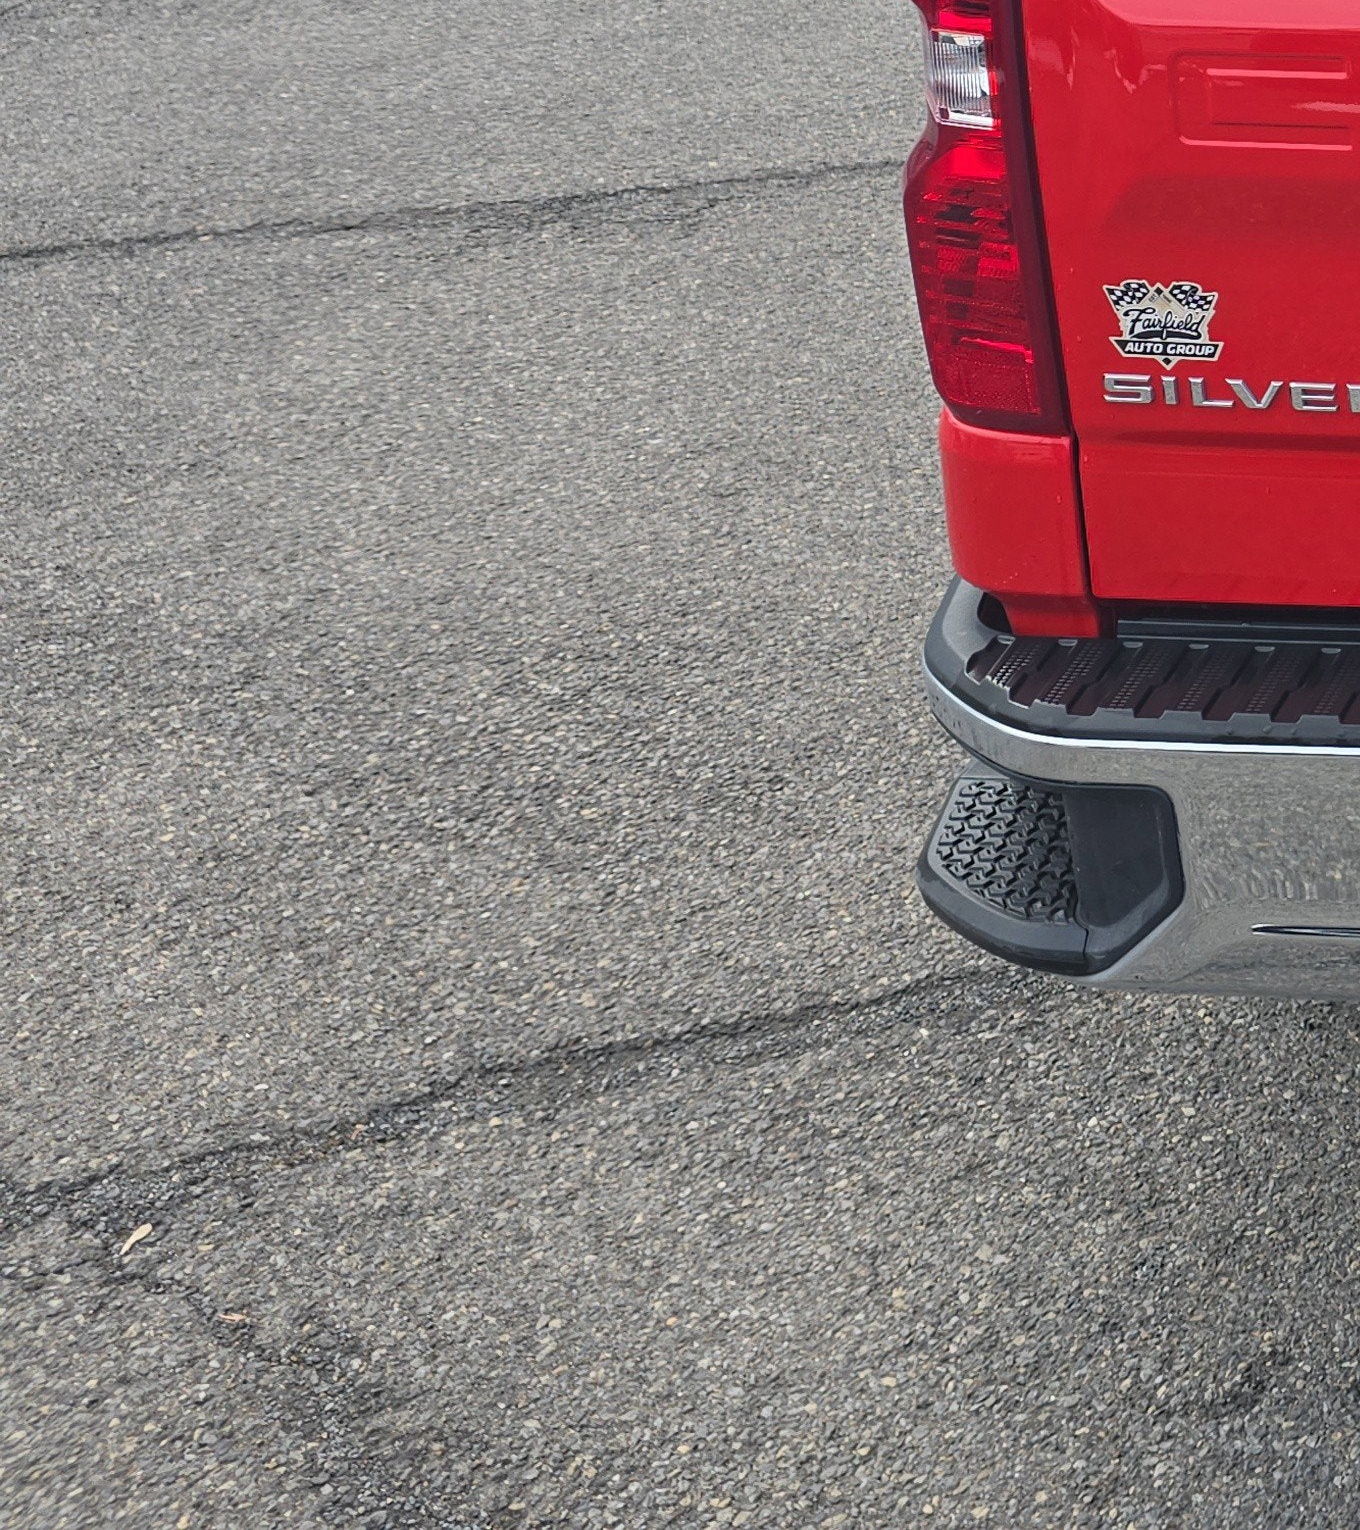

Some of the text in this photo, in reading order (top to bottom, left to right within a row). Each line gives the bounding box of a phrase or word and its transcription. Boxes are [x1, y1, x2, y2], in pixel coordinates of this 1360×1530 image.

[1122, 306, 1206, 340] Fairfield
[1125, 341, 1216, 357] AUTO GROUP
